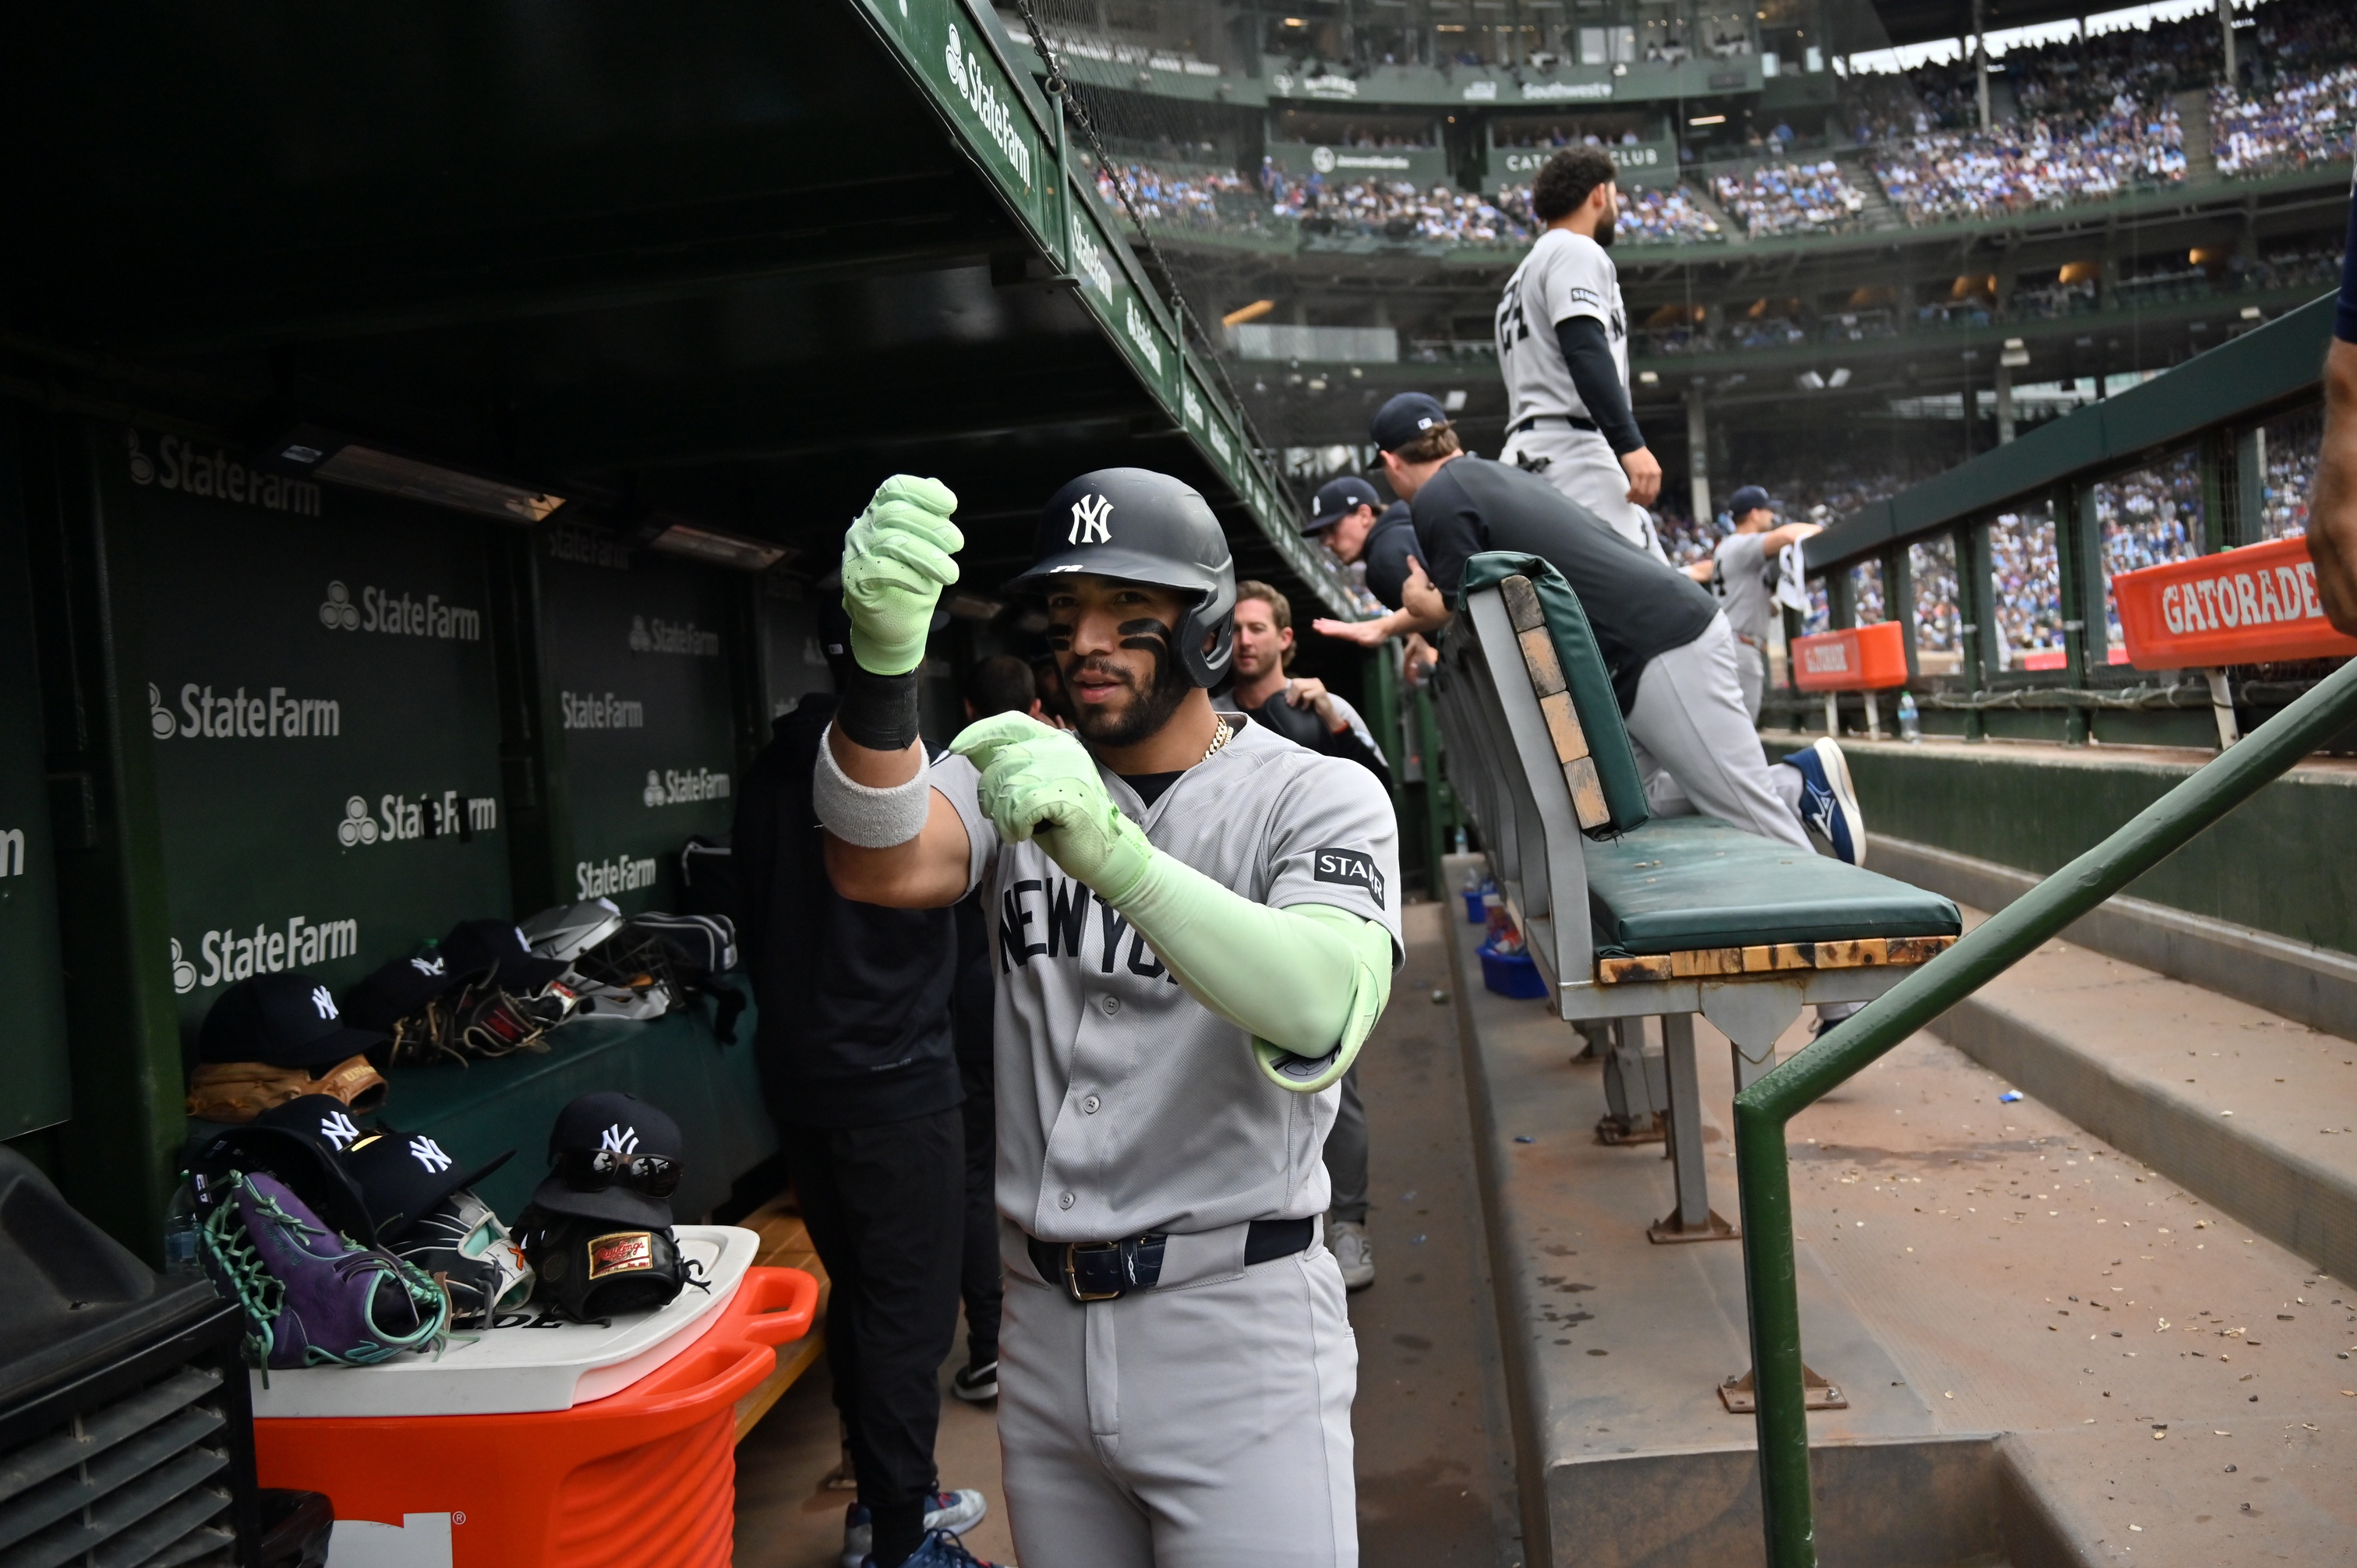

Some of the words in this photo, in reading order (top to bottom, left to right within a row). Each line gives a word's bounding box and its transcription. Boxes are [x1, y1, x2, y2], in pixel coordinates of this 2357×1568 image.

[968, 52, 1030, 188] StateFarm
[1068, 494, 1115, 546] NY
[362, 585, 480, 640] StateFarm
[2162, 562, 2324, 635] GATORADE
[180, 683, 340, 737] StateFarm
[576, 855, 656, 901] StateFarm
[200, 916, 358, 987] StateFarm
[999, 877, 1087, 975] NEW
[409, 1135, 452, 1174] NY
